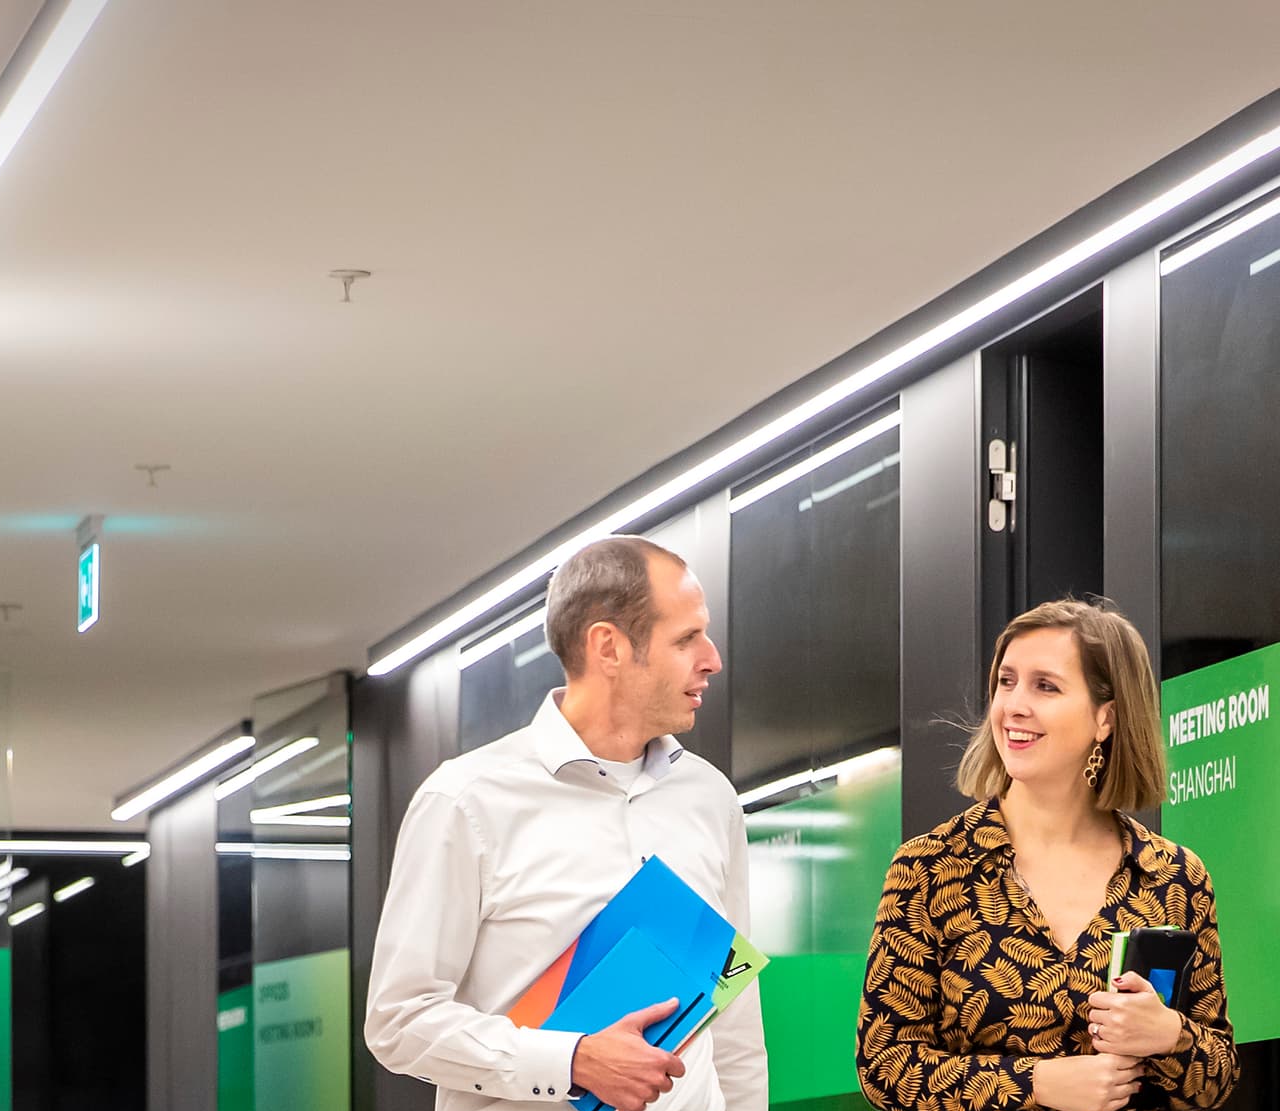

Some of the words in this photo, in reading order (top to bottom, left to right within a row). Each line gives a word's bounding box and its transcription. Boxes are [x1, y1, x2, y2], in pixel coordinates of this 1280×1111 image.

[1169, 698, 1226, 747] MEETING
[1228, 684, 1270, 730] ROOM
[1169, 755, 1236, 806] SHANGHAI
